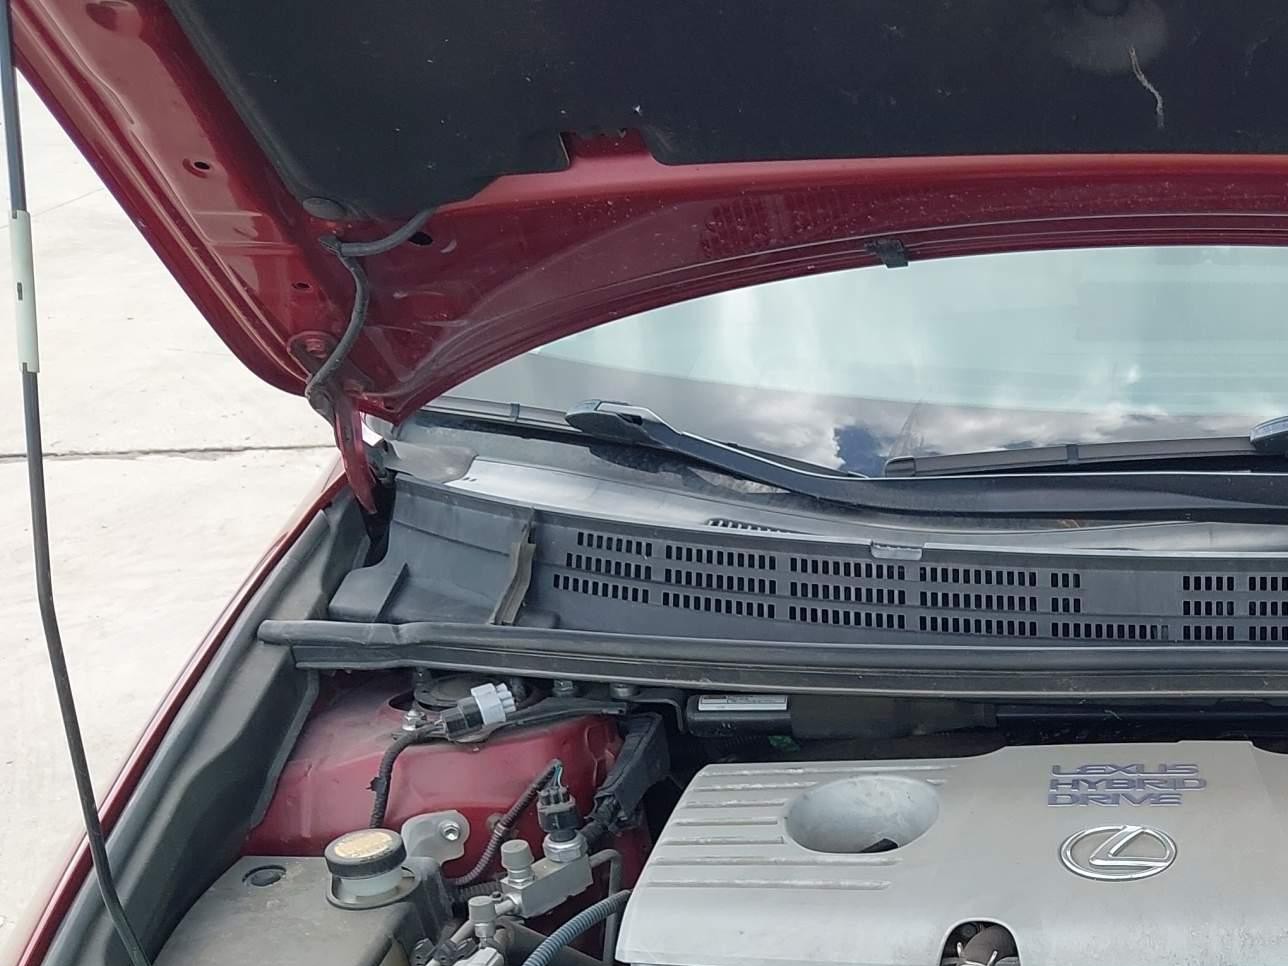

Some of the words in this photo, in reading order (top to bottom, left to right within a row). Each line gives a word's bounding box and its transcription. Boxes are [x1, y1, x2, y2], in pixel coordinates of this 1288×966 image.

[1051, 763, 1200, 777] LEXUS
[1049, 777, 1207, 792] HYBRID
[1047, 792, 1183, 807] DRIVE
